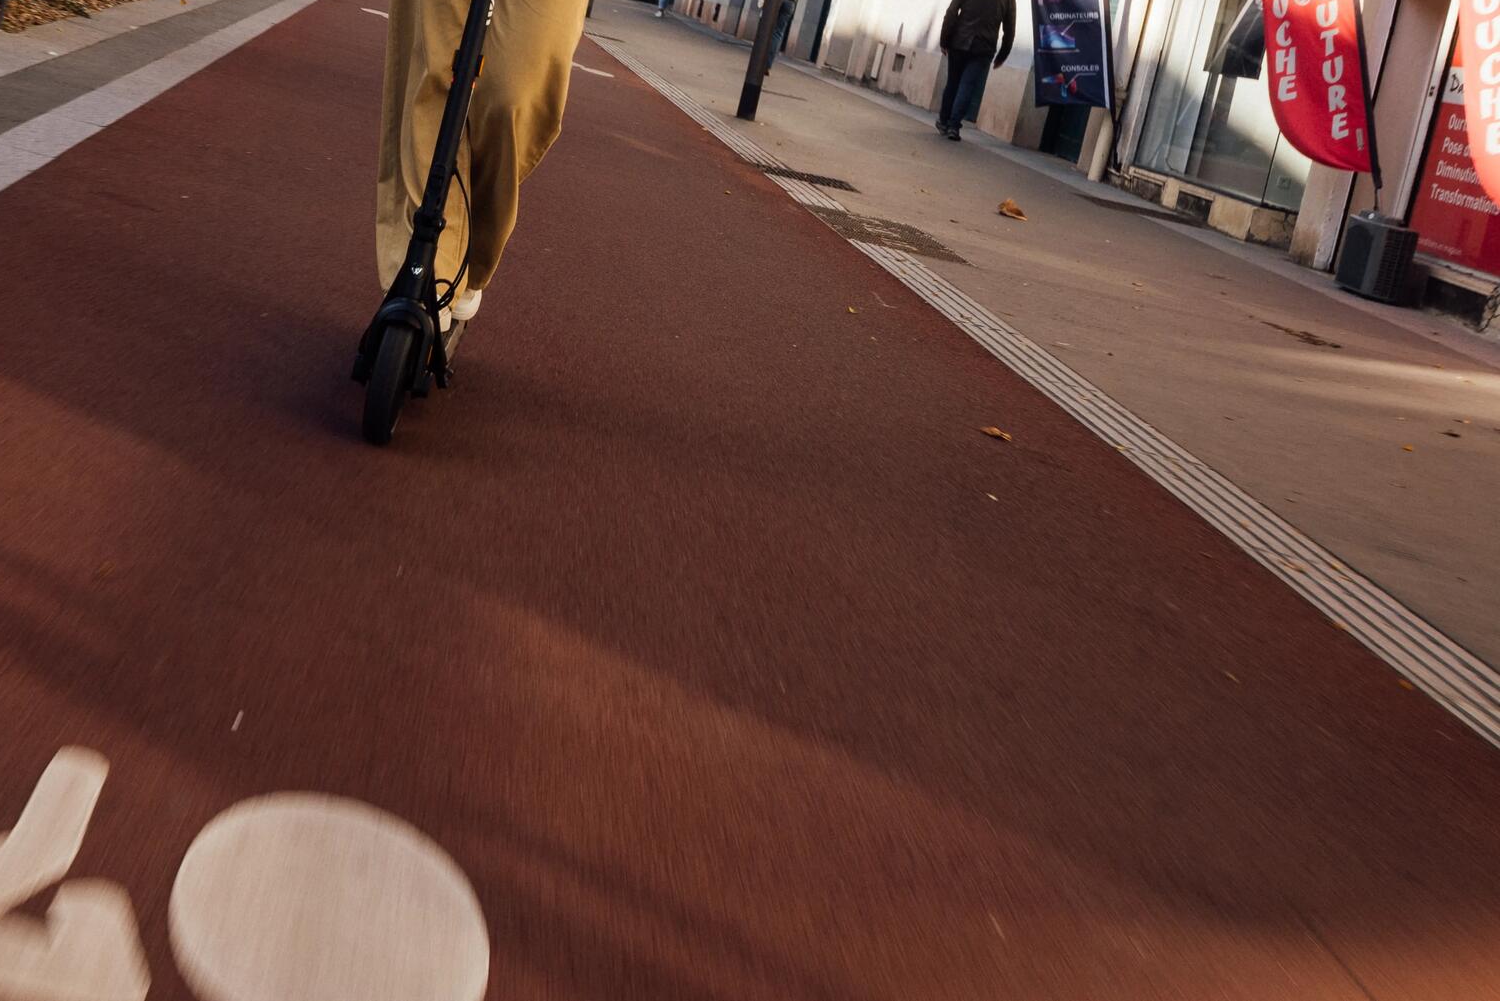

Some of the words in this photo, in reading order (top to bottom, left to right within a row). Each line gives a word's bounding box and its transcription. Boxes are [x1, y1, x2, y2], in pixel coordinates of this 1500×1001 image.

[1050, 12, 1099, 20] ORDINATEURS
[1061, 64, 1099, 72] CONSOLES
[1441, 137, 1463, 157] Pose
